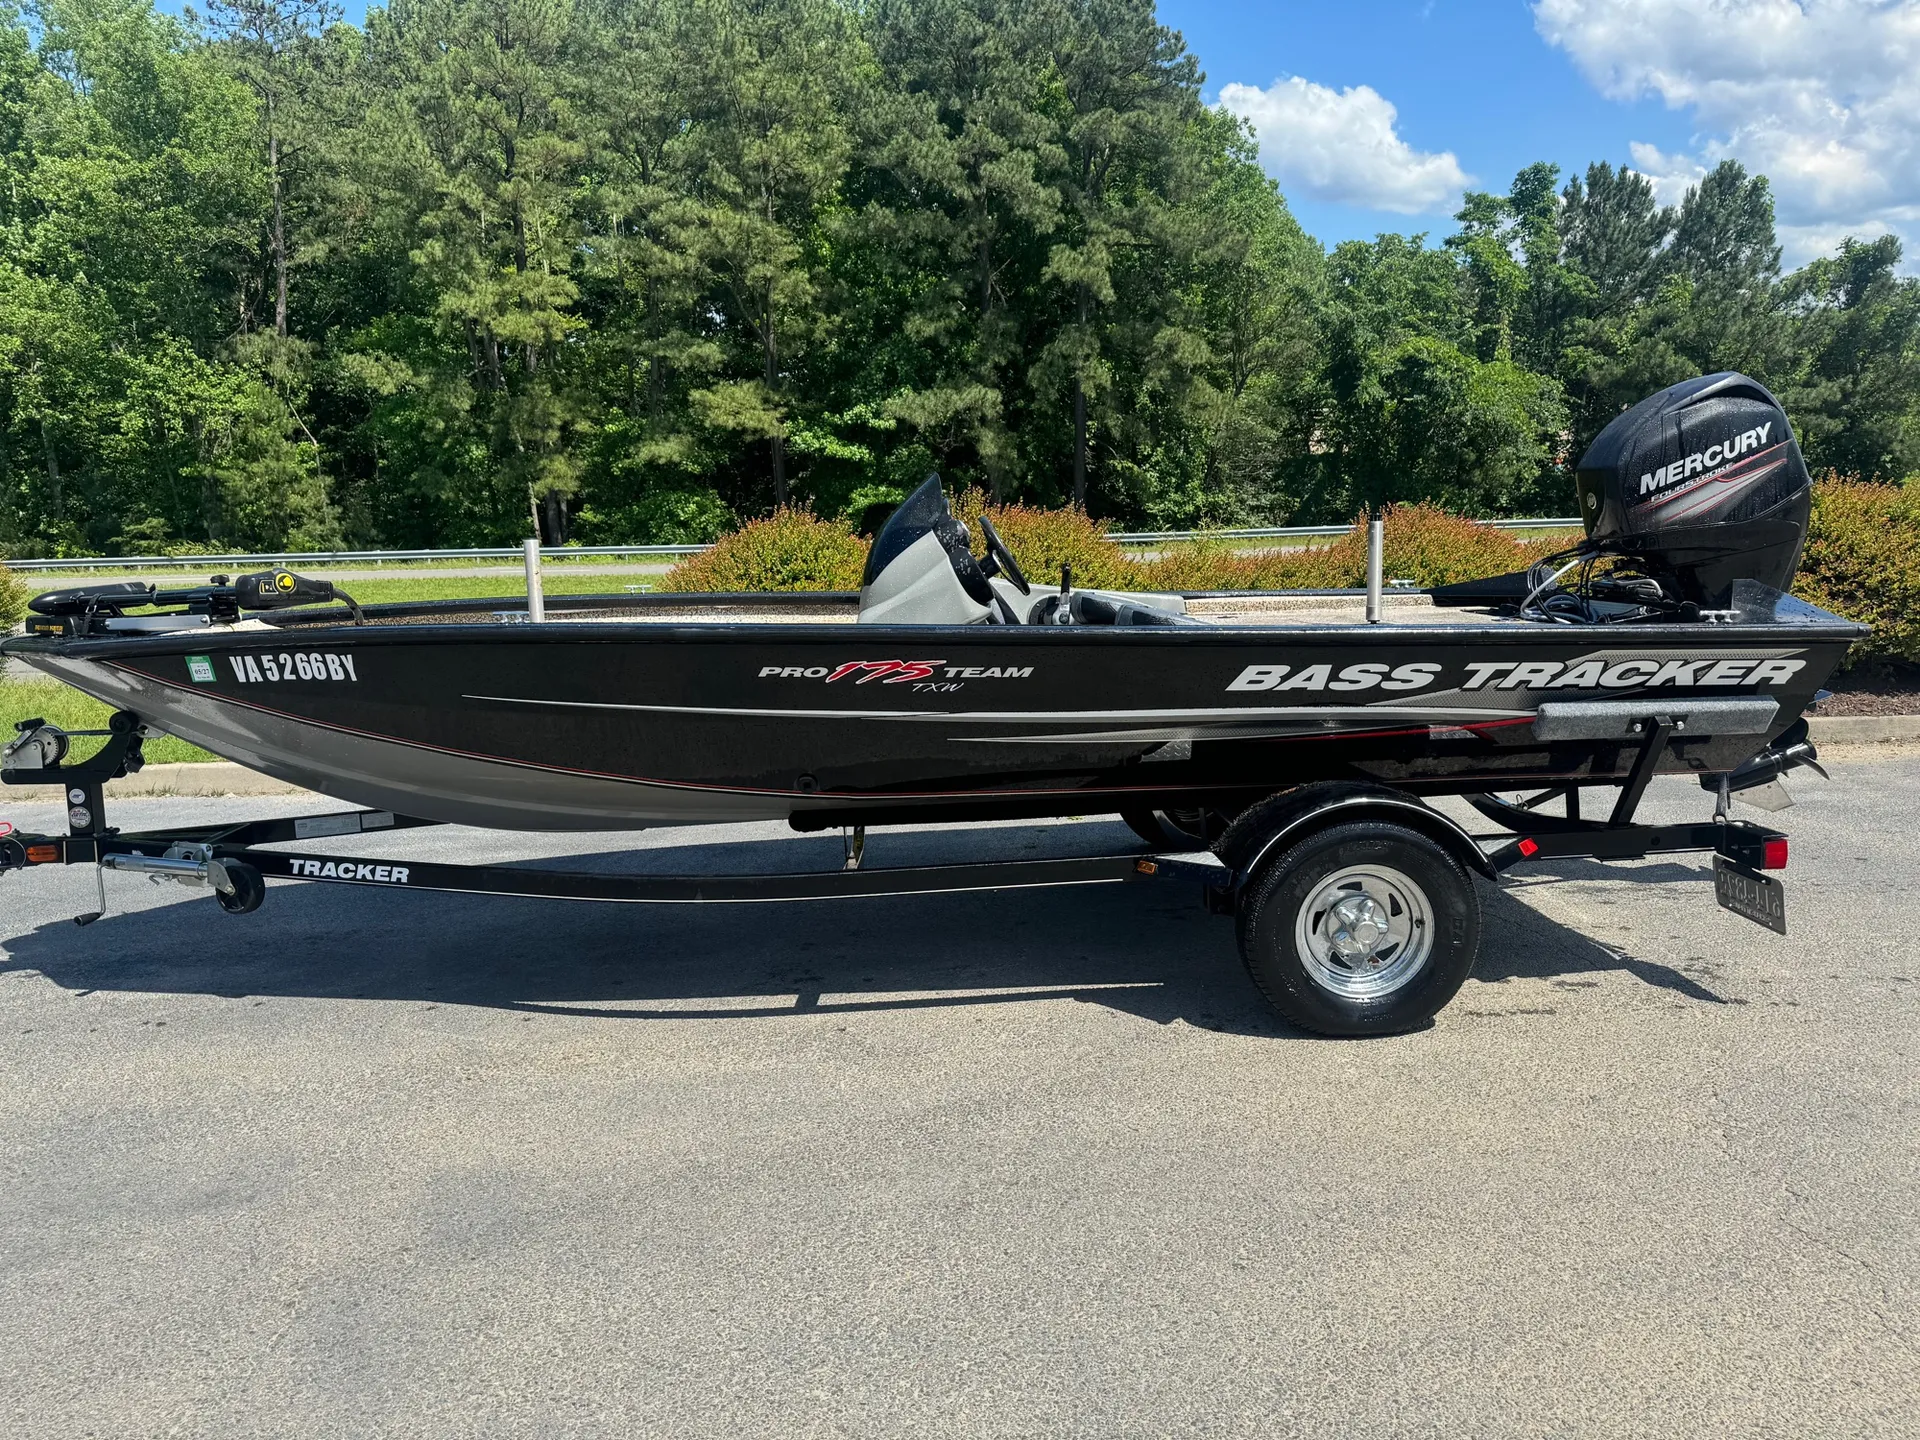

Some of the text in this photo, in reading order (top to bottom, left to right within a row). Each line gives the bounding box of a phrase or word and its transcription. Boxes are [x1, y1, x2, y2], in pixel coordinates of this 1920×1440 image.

[1639, 421, 1772, 495] MERCURY
[1651, 462, 1735, 503] FOURSTROKE
[757, 660, 1035, 684] PRO 175 TEAM
[1225, 659, 1808, 691] BASS TRACKER
[912, 682, 966, 693] TXW
[289, 858, 410, 883] TRACKER
